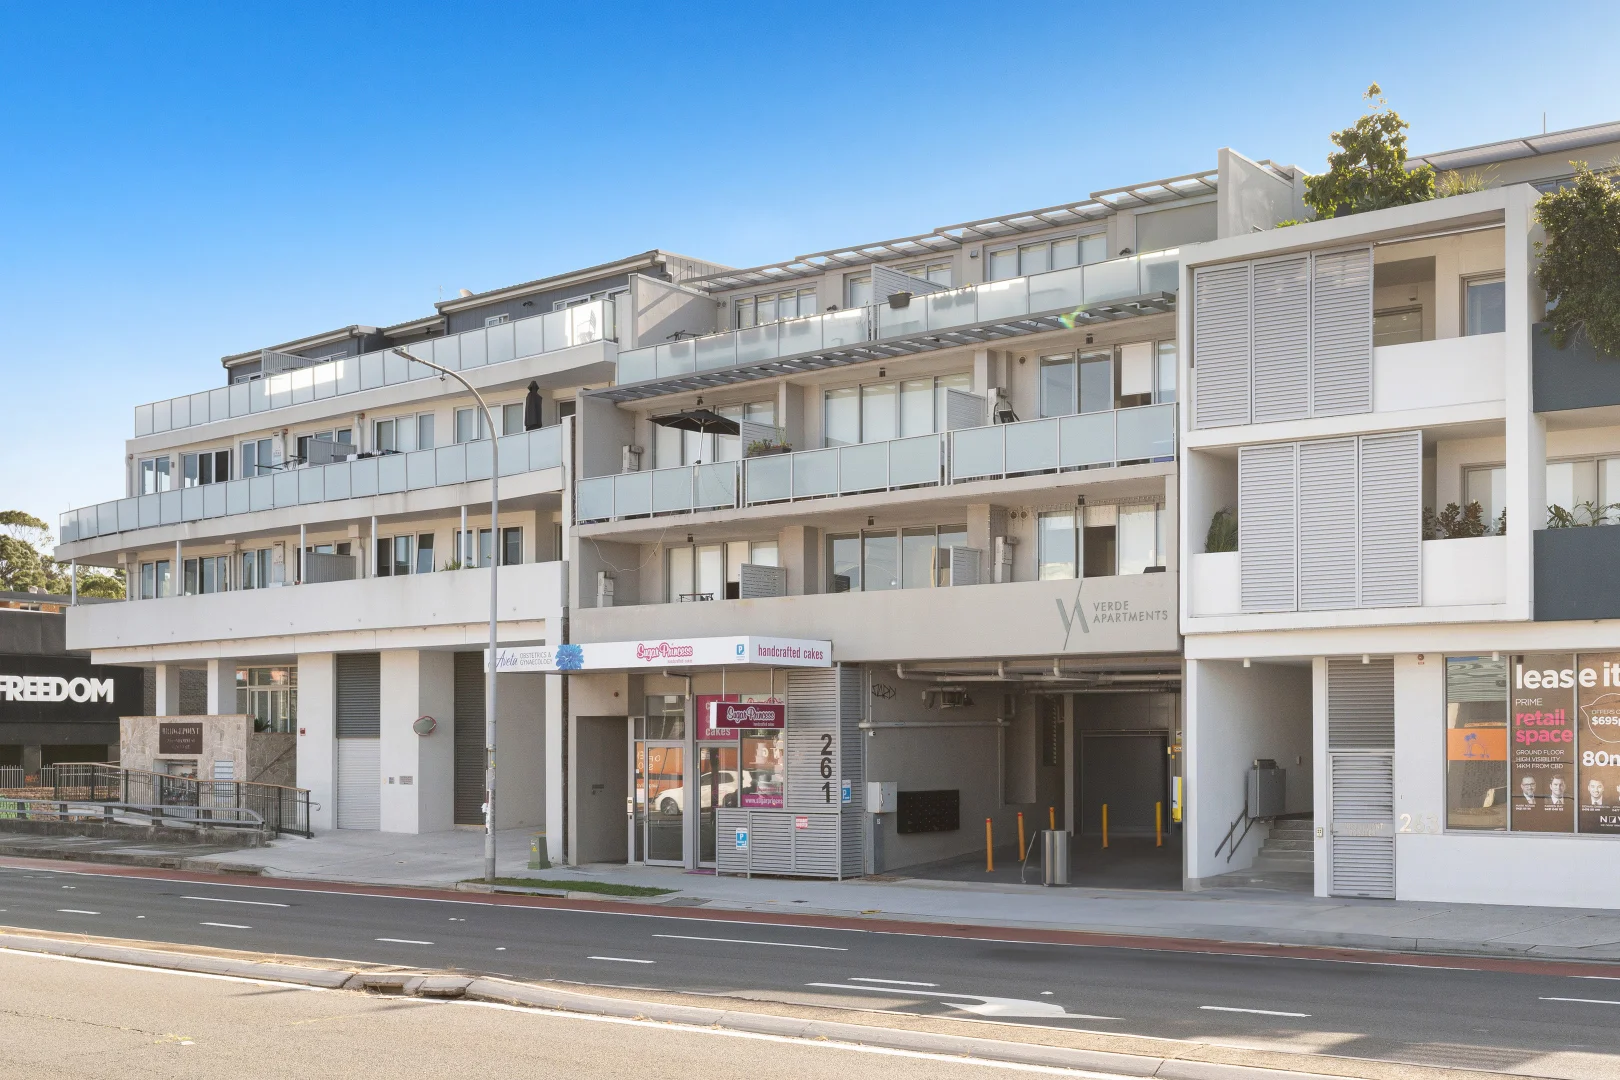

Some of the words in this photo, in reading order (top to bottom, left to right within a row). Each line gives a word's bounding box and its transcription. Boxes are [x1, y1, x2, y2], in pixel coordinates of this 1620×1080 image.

[1093, 601, 1129, 612] VERDE
[1093, 610, 1168, 624] APARTMENTS
[519, 651, 547, 659] OBSTETRICS
[636, 643, 660, 662] Sugar
[659, 642, 693, 658] Princess
[758, 644, 801, 659] handcrafted
[803, 647, 824, 660] cakes
[1516, 663, 1598, 690] lease
[1602, 661, 1620, 688] it
[1515, 697, 1543, 707] PRIME
[726, 705, 747, 724] Sugar
[746, 706, 776, 721] Princess
[1515, 708, 1565, 727] retail
[705, 728, 731, 737] cakes
[1515, 728, 1573, 746] space
[820, 733, 833, 804] 261
